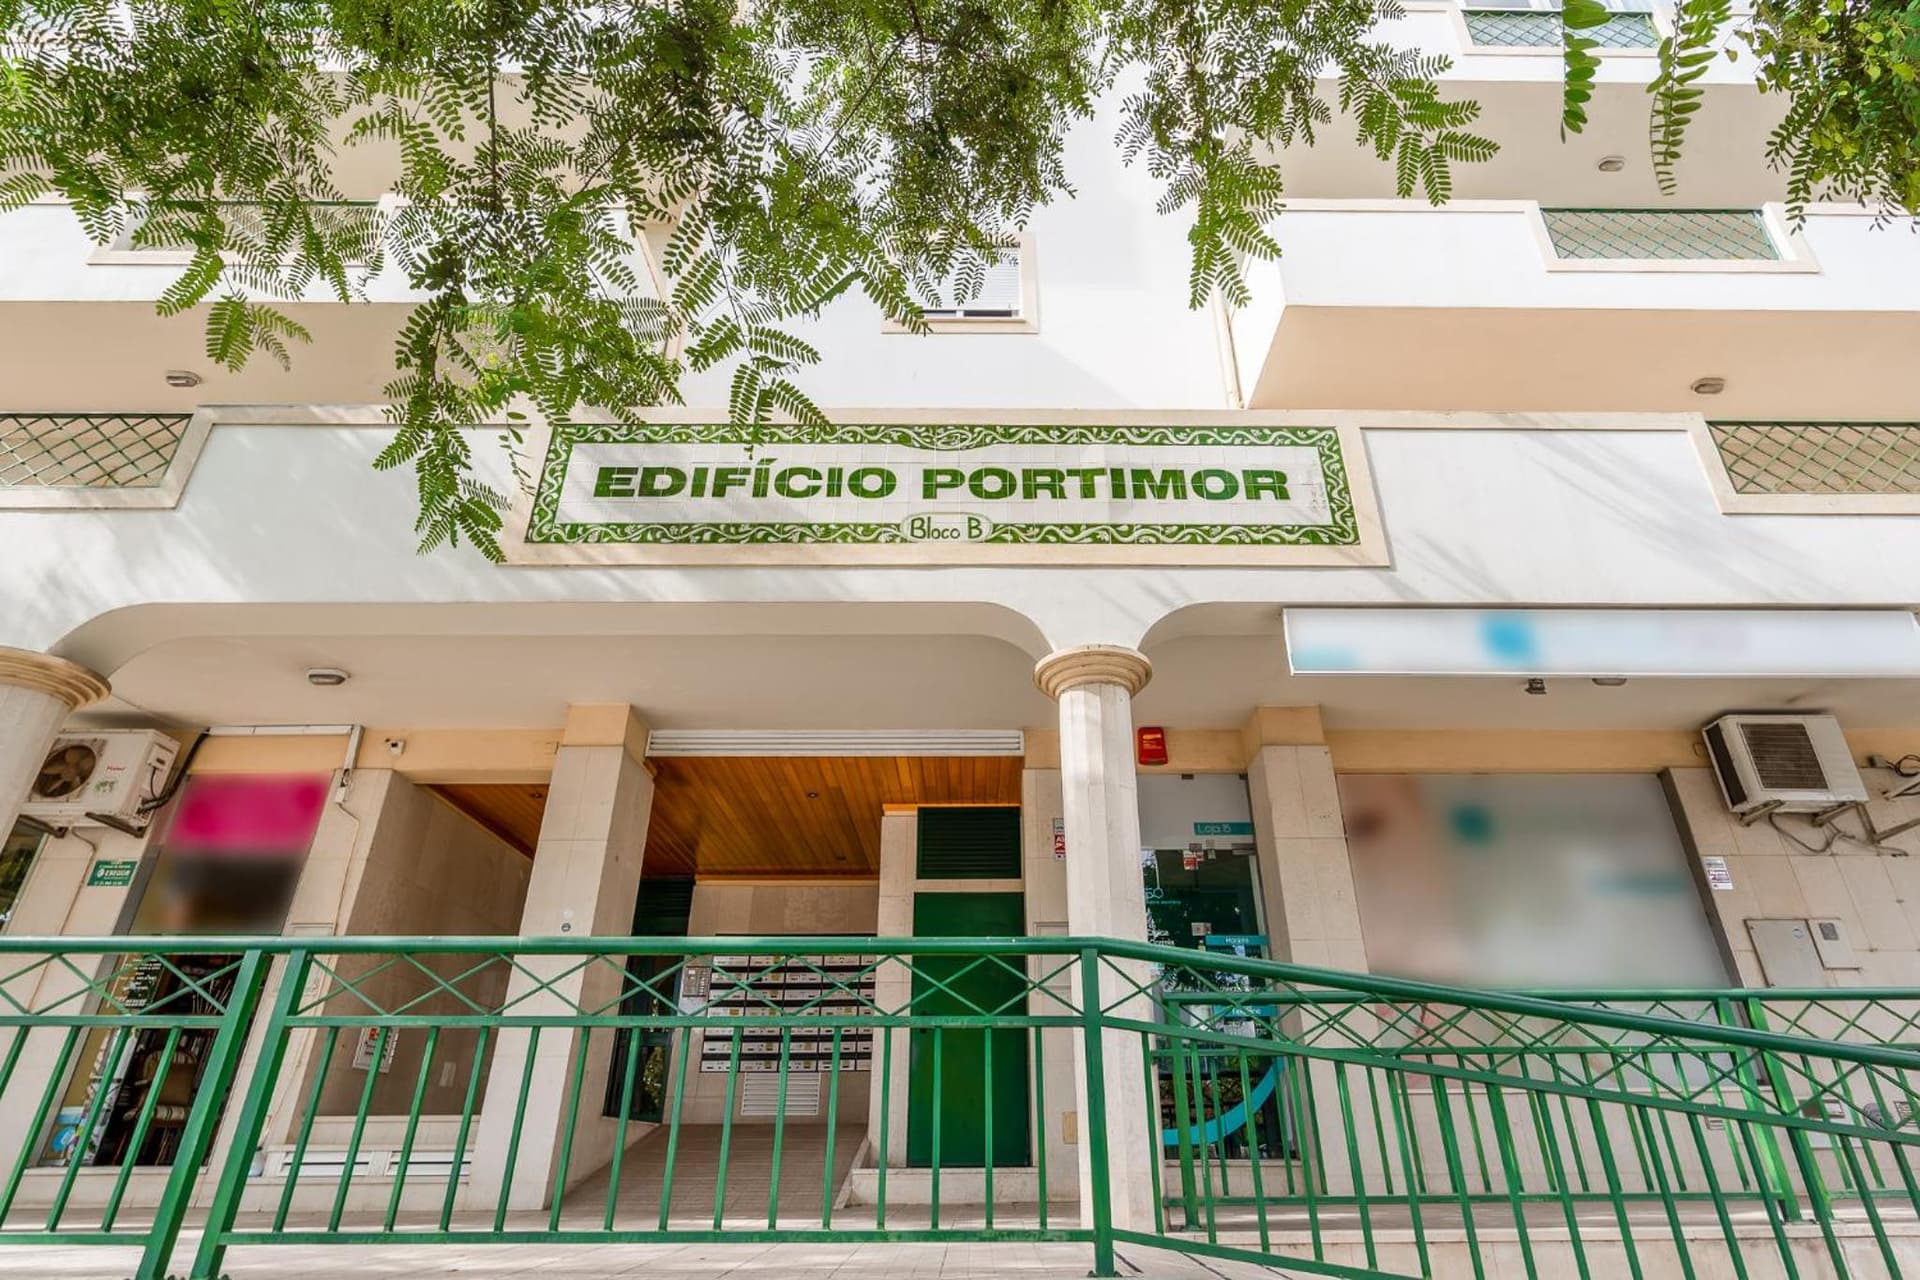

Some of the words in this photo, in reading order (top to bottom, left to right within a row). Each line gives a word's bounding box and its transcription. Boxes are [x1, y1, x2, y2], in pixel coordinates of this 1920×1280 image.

[593, 458, 897, 498] EDIFÍCIO
[922, 468, 1290, 500] PORTIMOR
[910, 516, 961, 540] Bloco
[967, 516, 983, 539] B
